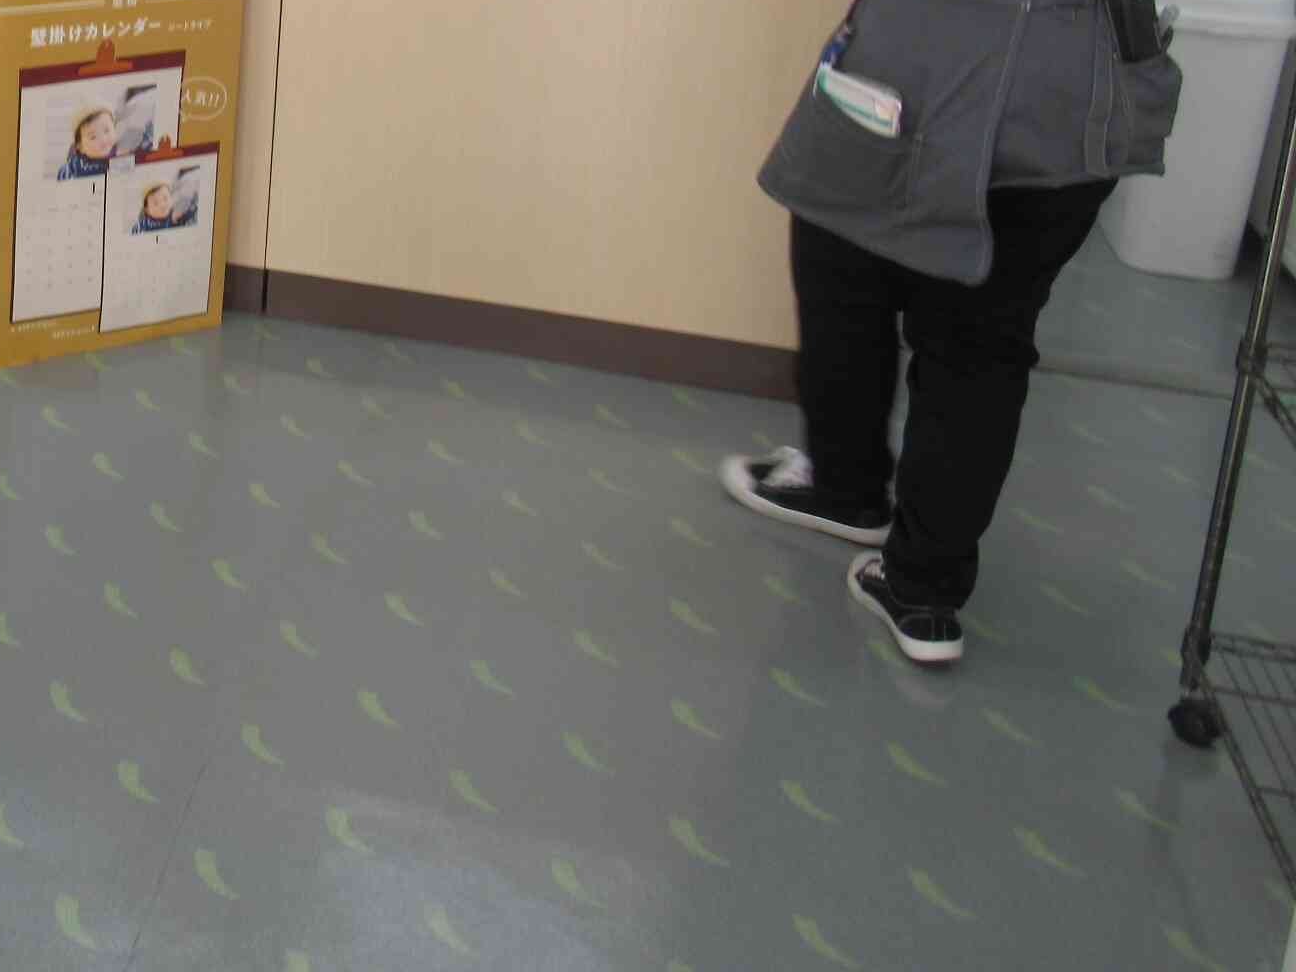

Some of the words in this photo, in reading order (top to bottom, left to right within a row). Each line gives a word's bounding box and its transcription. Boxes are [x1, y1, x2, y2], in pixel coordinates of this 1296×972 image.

[30, 17, 161, 48] 壁掛けカレンダー
